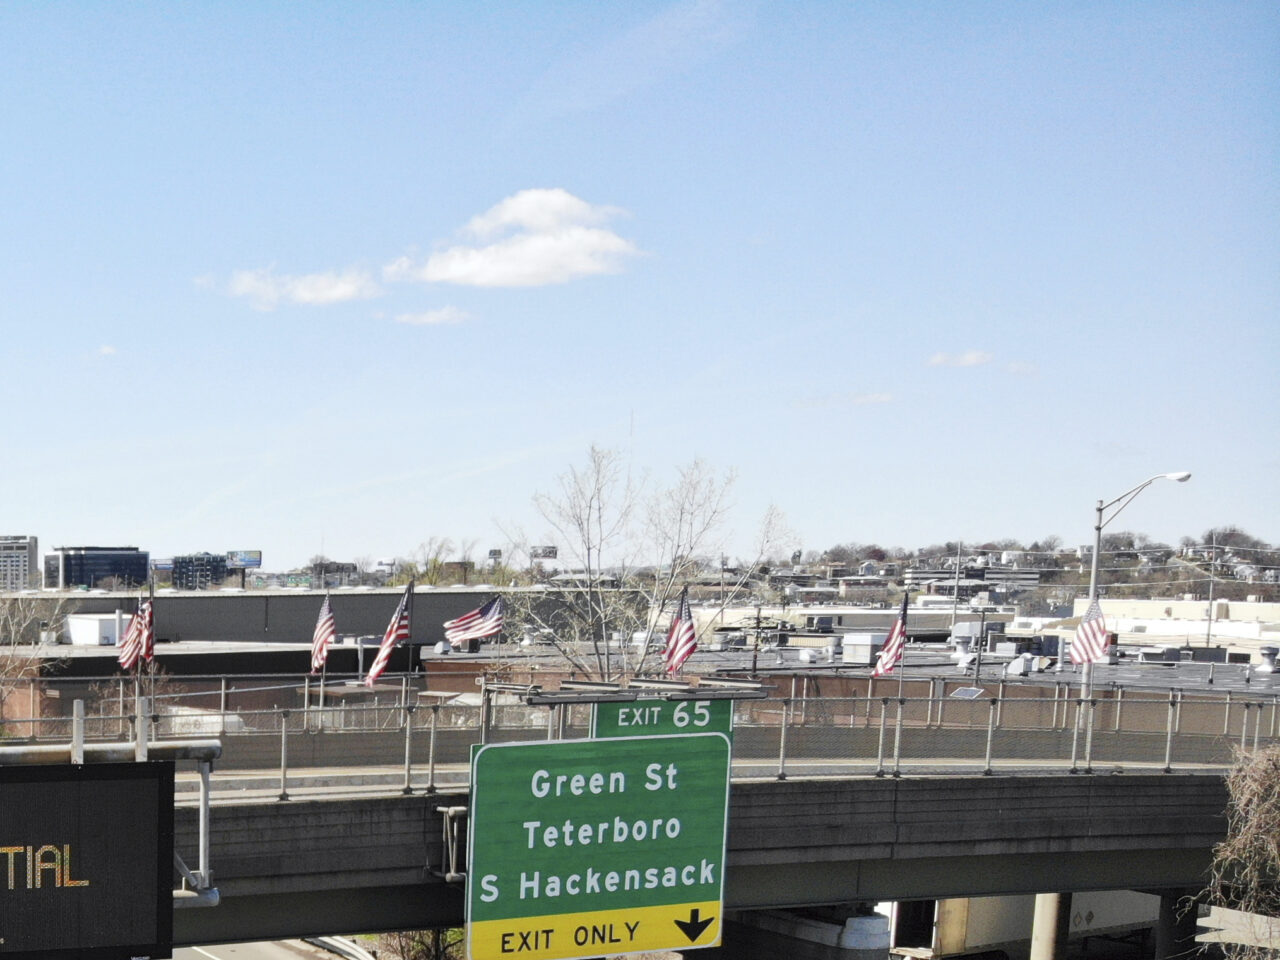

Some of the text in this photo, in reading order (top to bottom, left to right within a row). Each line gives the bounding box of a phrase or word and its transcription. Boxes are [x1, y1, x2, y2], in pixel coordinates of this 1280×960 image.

[618, 700, 711, 728] EXIT 65
[531, 763, 677, 798] Green St
[523, 816, 681, 849] Teterboro
[480, 858, 716, 902] S Hackensack
[501, 921, 640, 953] EXIT ONLY
